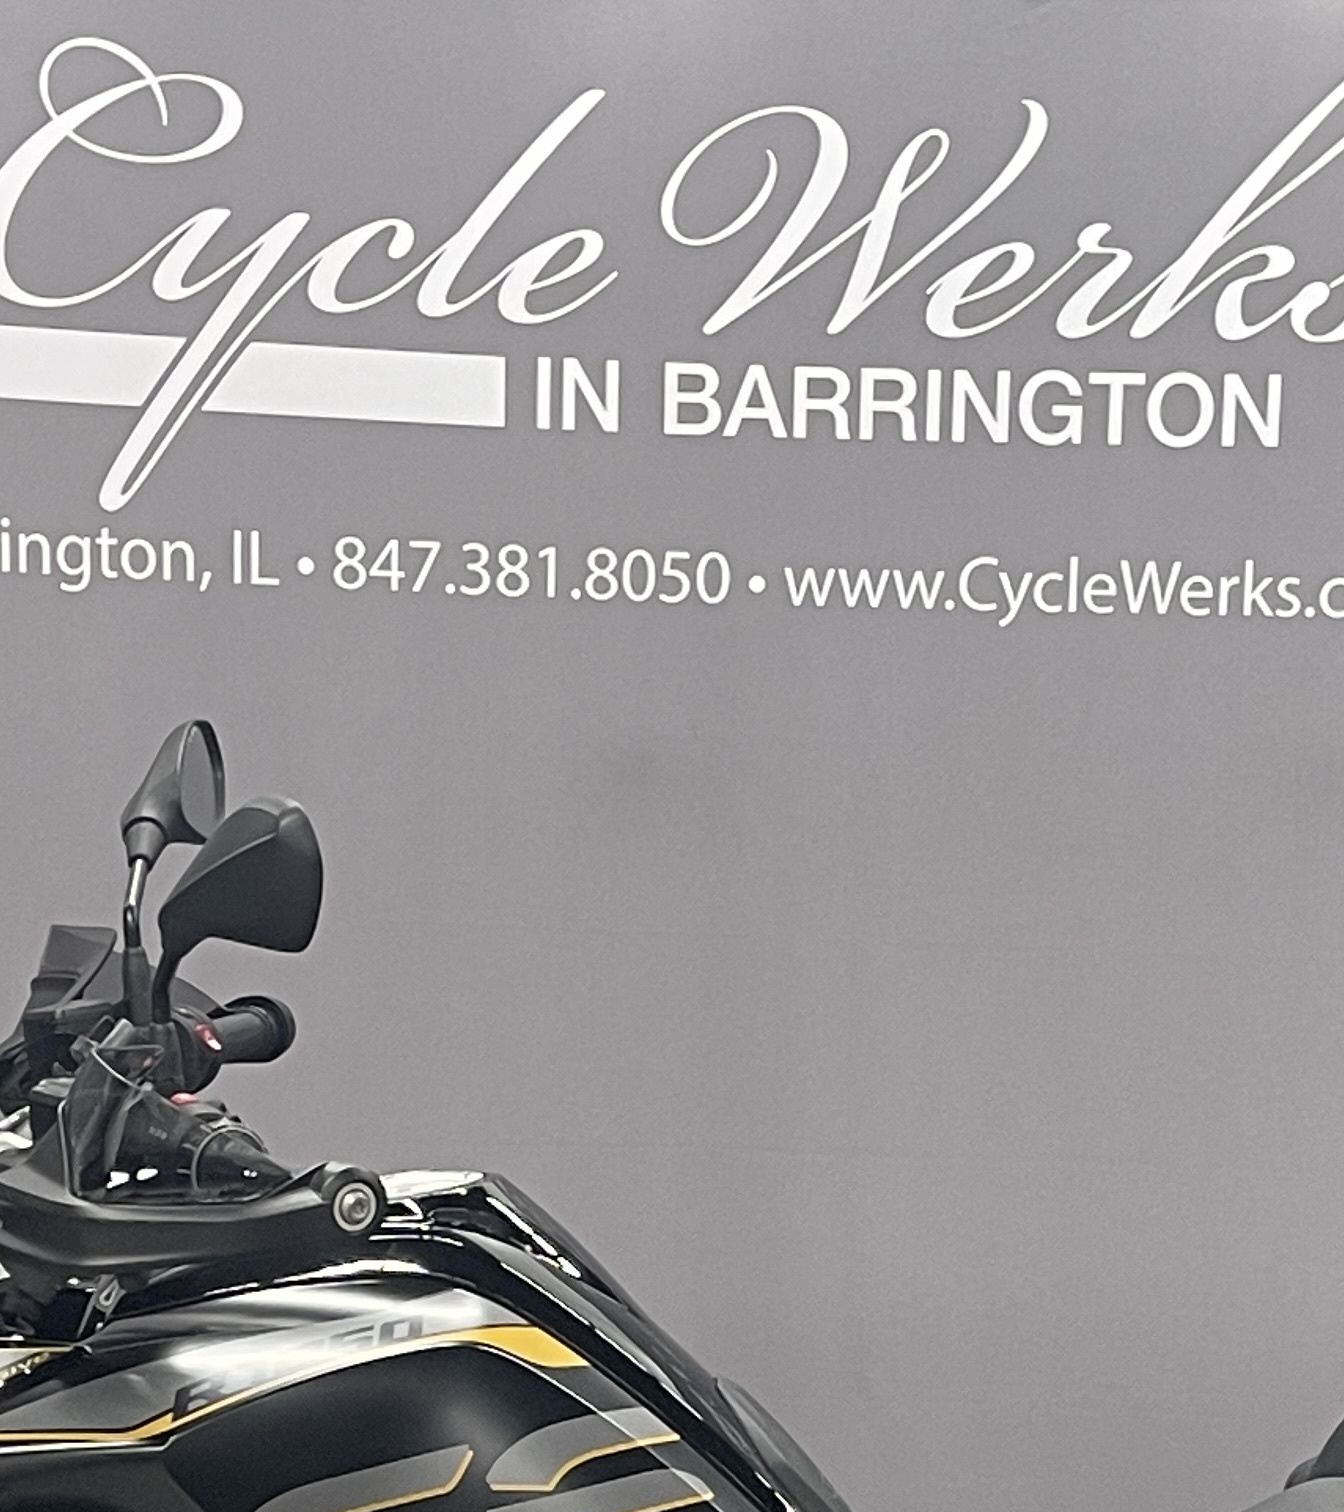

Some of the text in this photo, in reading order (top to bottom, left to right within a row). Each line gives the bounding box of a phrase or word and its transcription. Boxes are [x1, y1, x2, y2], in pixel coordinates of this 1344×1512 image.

[536, 355, 1283, 449] IN BARRINGTON
[232, 528, 281, 587] IL
[332, 536, 732, 605] 847.381.8050
